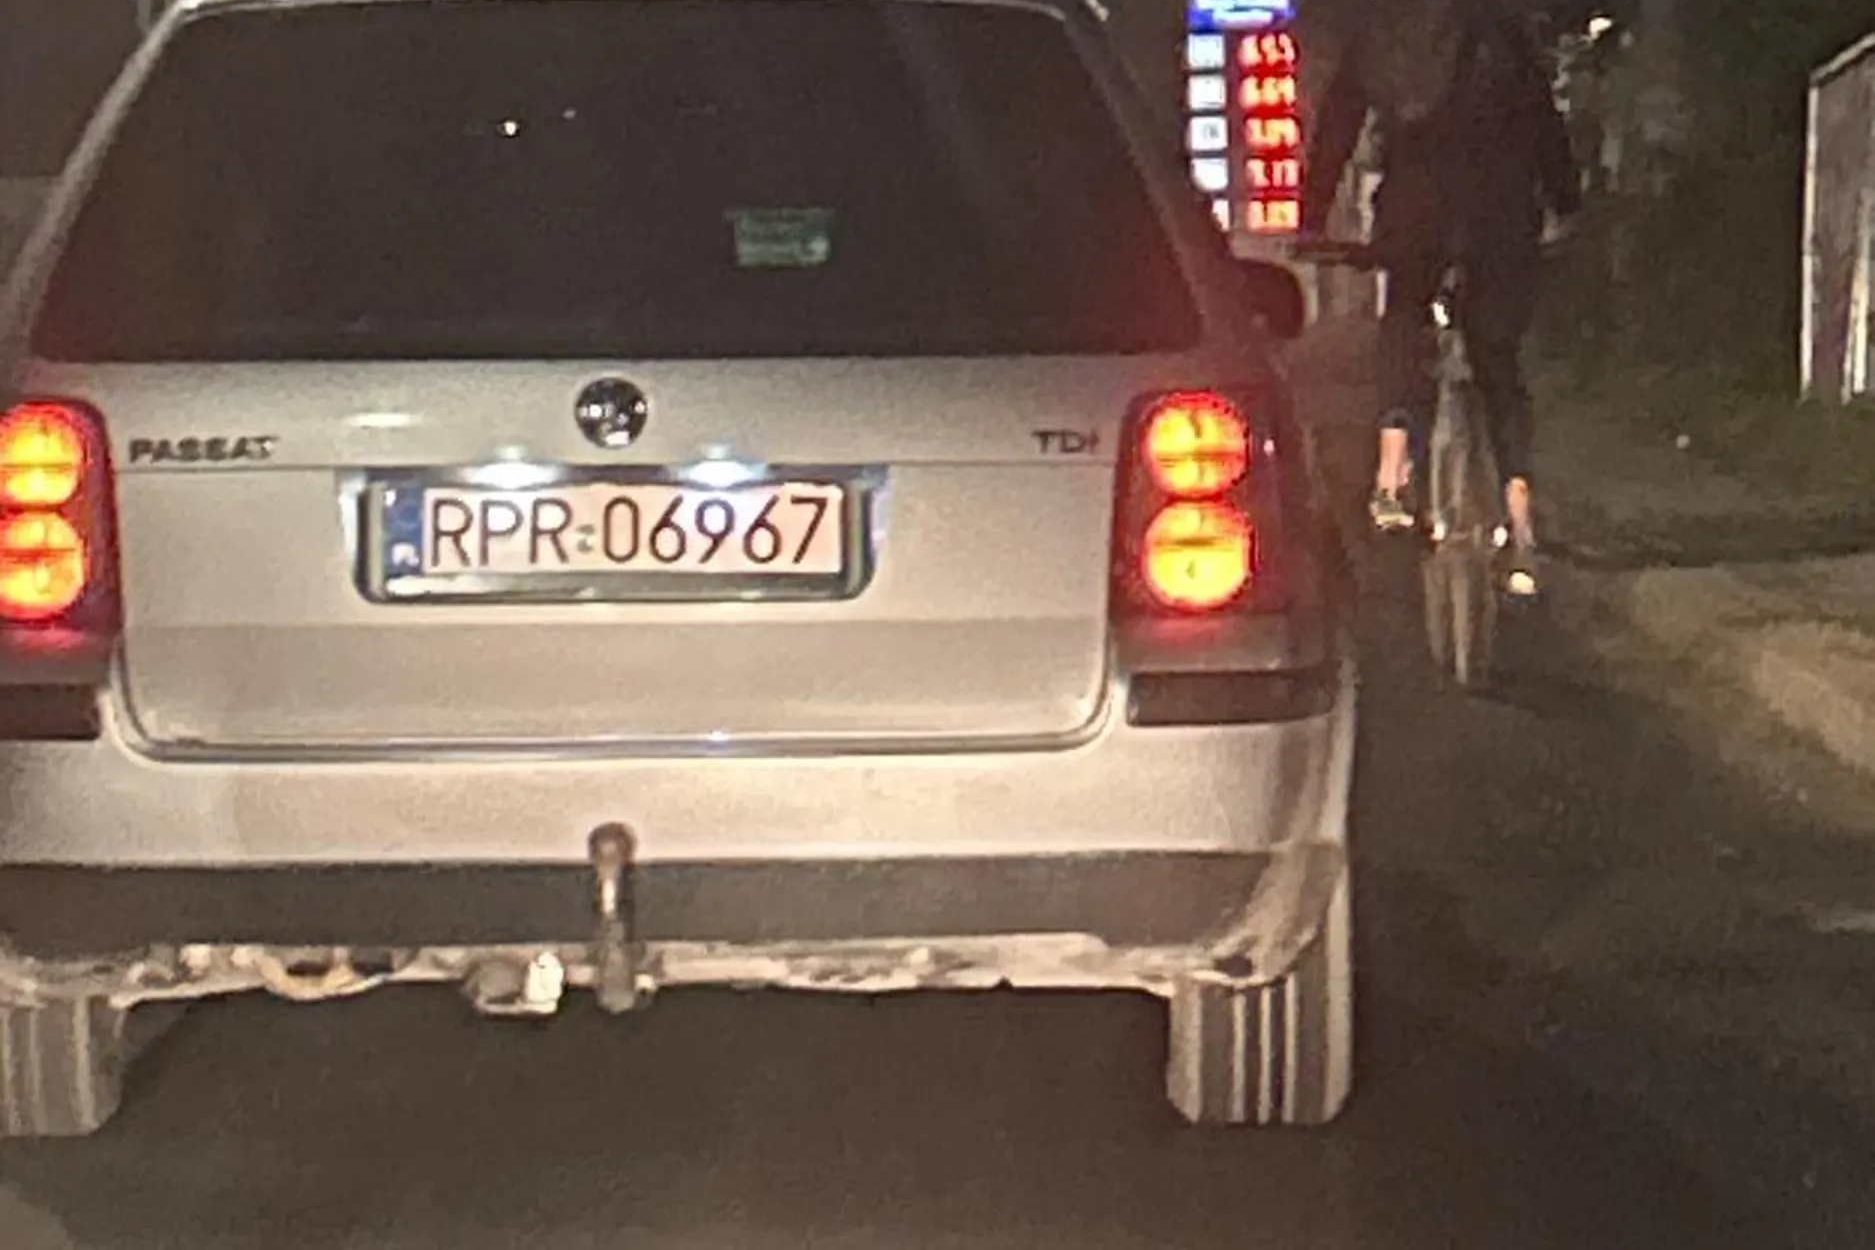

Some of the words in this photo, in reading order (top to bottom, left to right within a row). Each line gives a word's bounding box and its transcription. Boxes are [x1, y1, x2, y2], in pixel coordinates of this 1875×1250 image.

[130, 435, 280, 463] PASSAT
[430, 497, 574, 567] RPR
[602, 494, 829, 565] 06967
